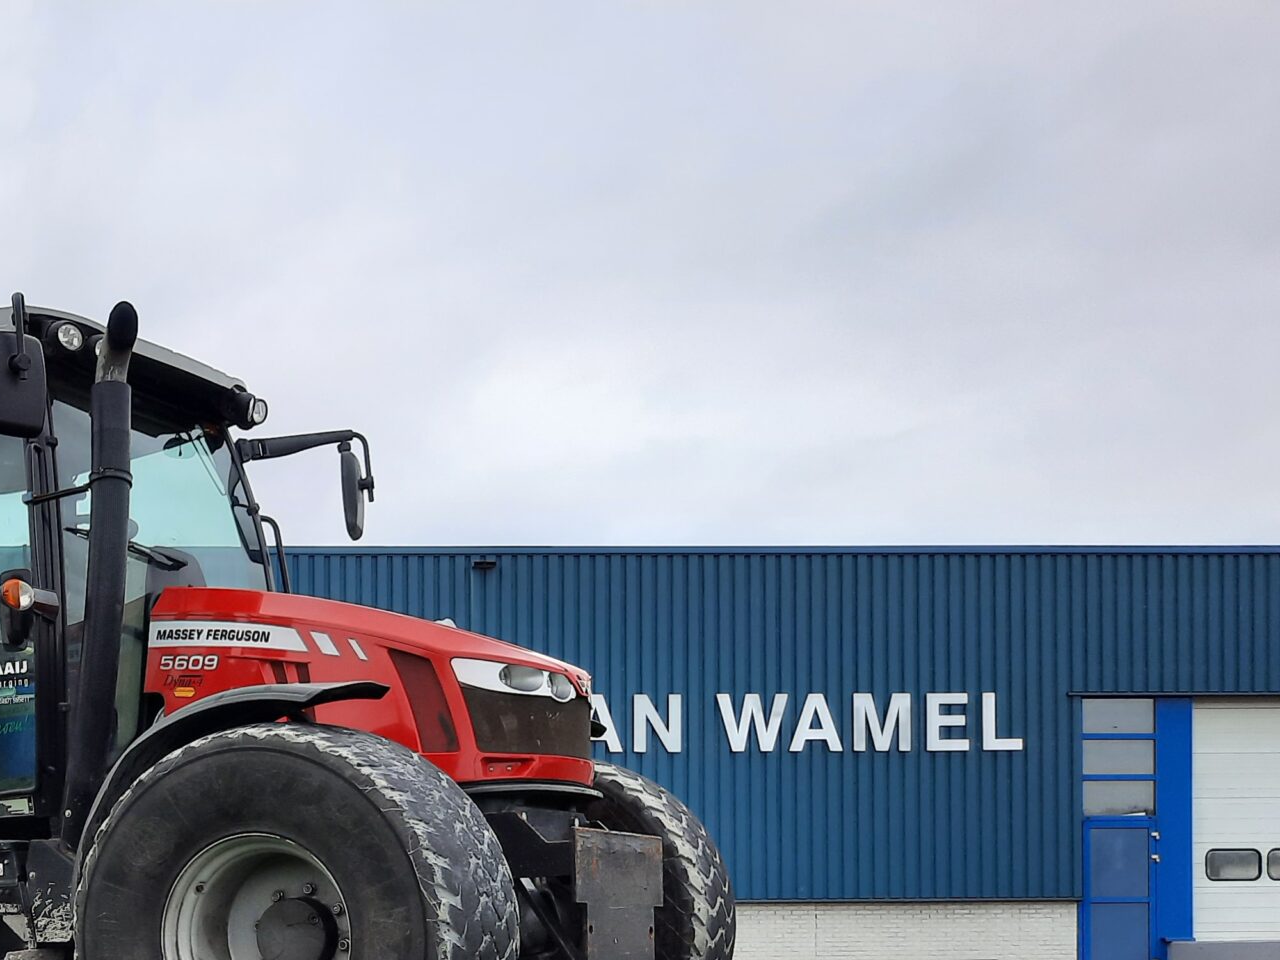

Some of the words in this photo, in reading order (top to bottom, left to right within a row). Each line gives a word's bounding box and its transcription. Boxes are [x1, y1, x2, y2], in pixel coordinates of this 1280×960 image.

[156, 629, 203, 641] MASSEY
[206, 630, 271, 643] FERGUSON
[160, 655, 218, 670] 5609
[590, 693, 682, 752] AN
[716, 692, 1023, 752] WAMEL
